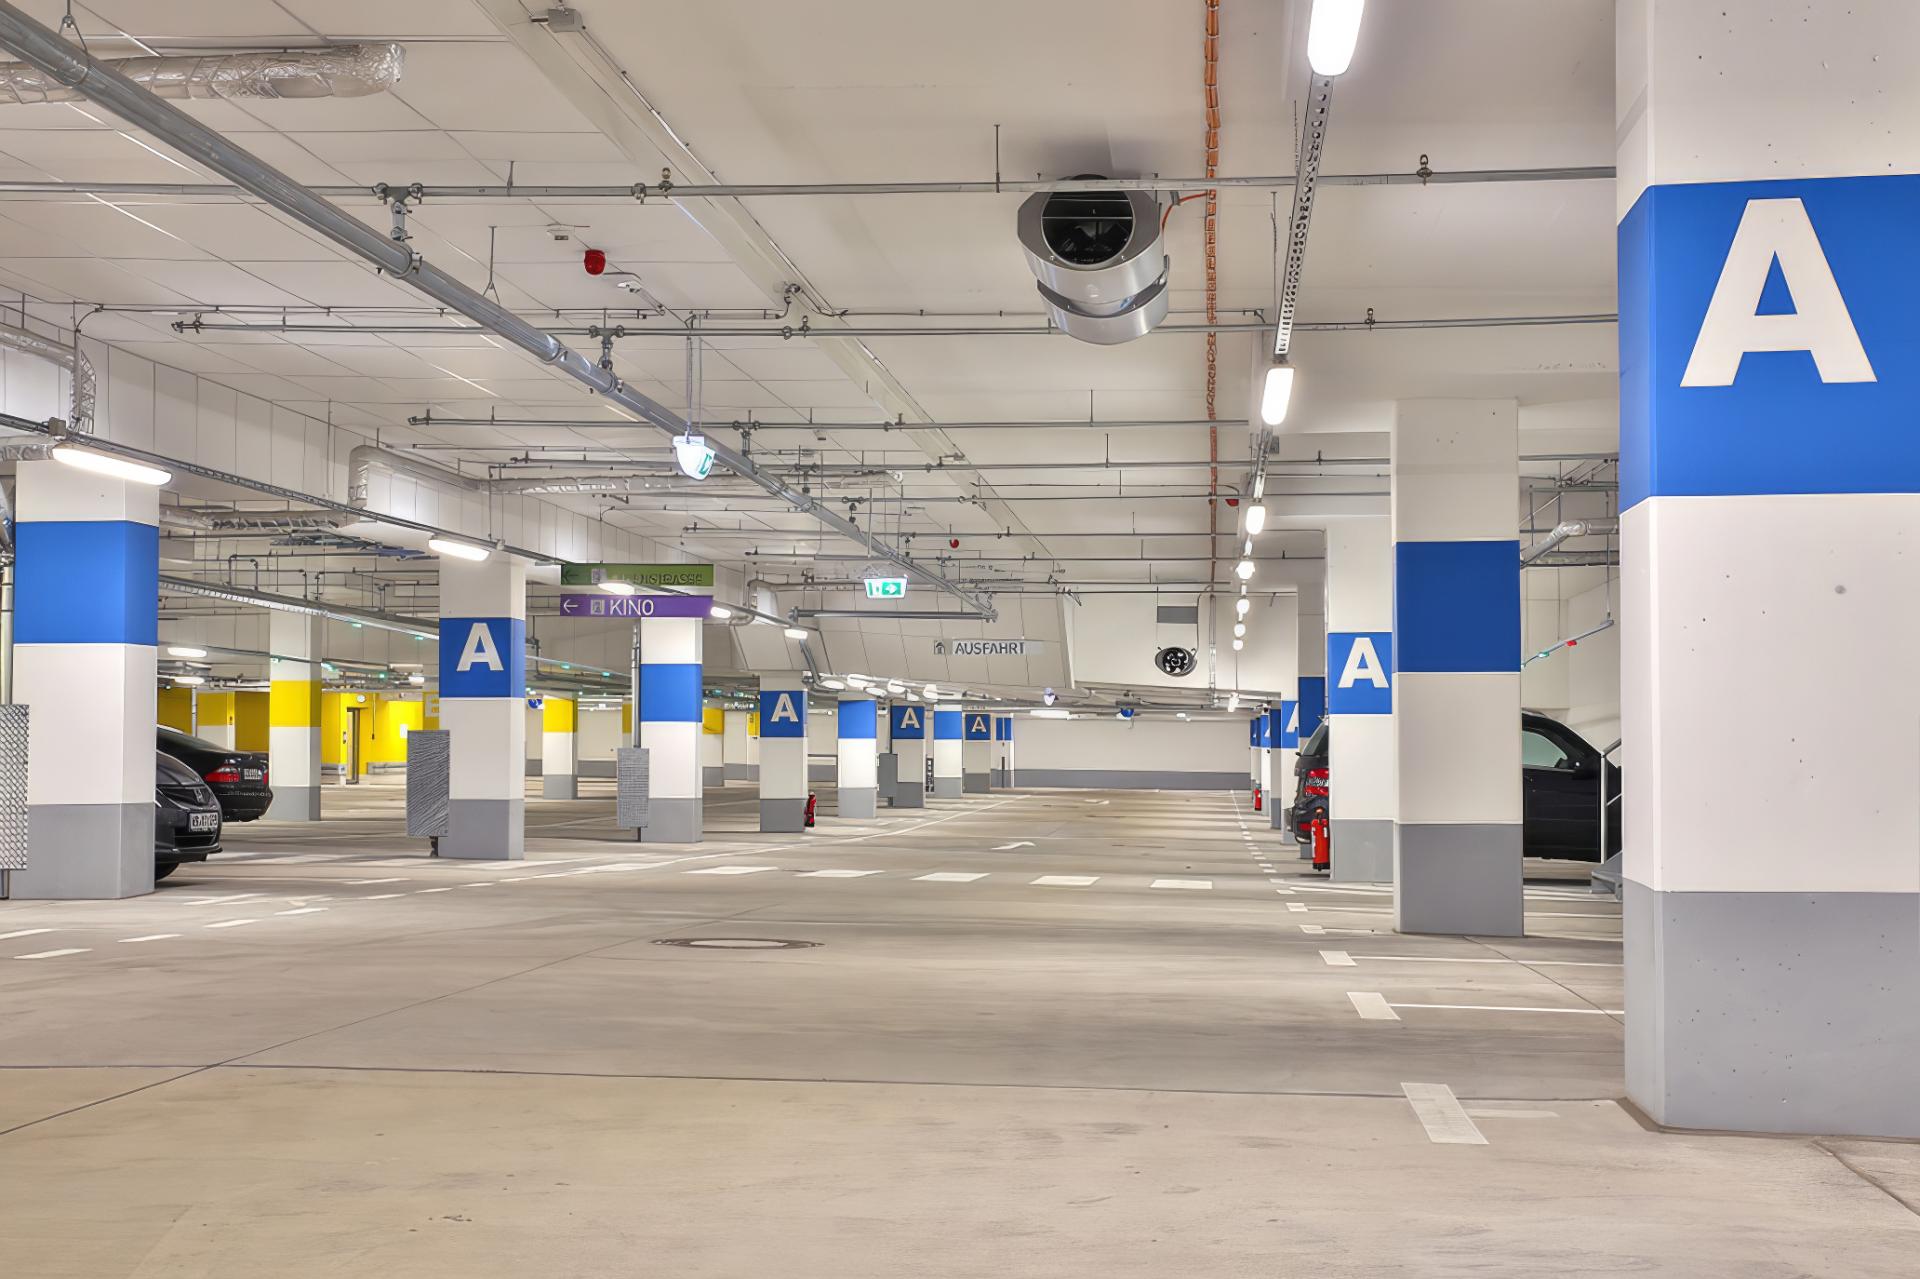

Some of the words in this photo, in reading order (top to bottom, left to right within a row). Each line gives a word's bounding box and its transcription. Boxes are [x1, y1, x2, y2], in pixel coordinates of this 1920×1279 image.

[1680, 198, 1877, 387] A
[609, 599, 654, 616] KINO
[456, 622, 504, 672] A
[955, 642, 1025, 655] AUSFAHRT
[1337, 637, 1390, 689] A
[770, 693, 799, 723] A
[900, 707, 921, 729] A
[971, 715, 987, 733] A
